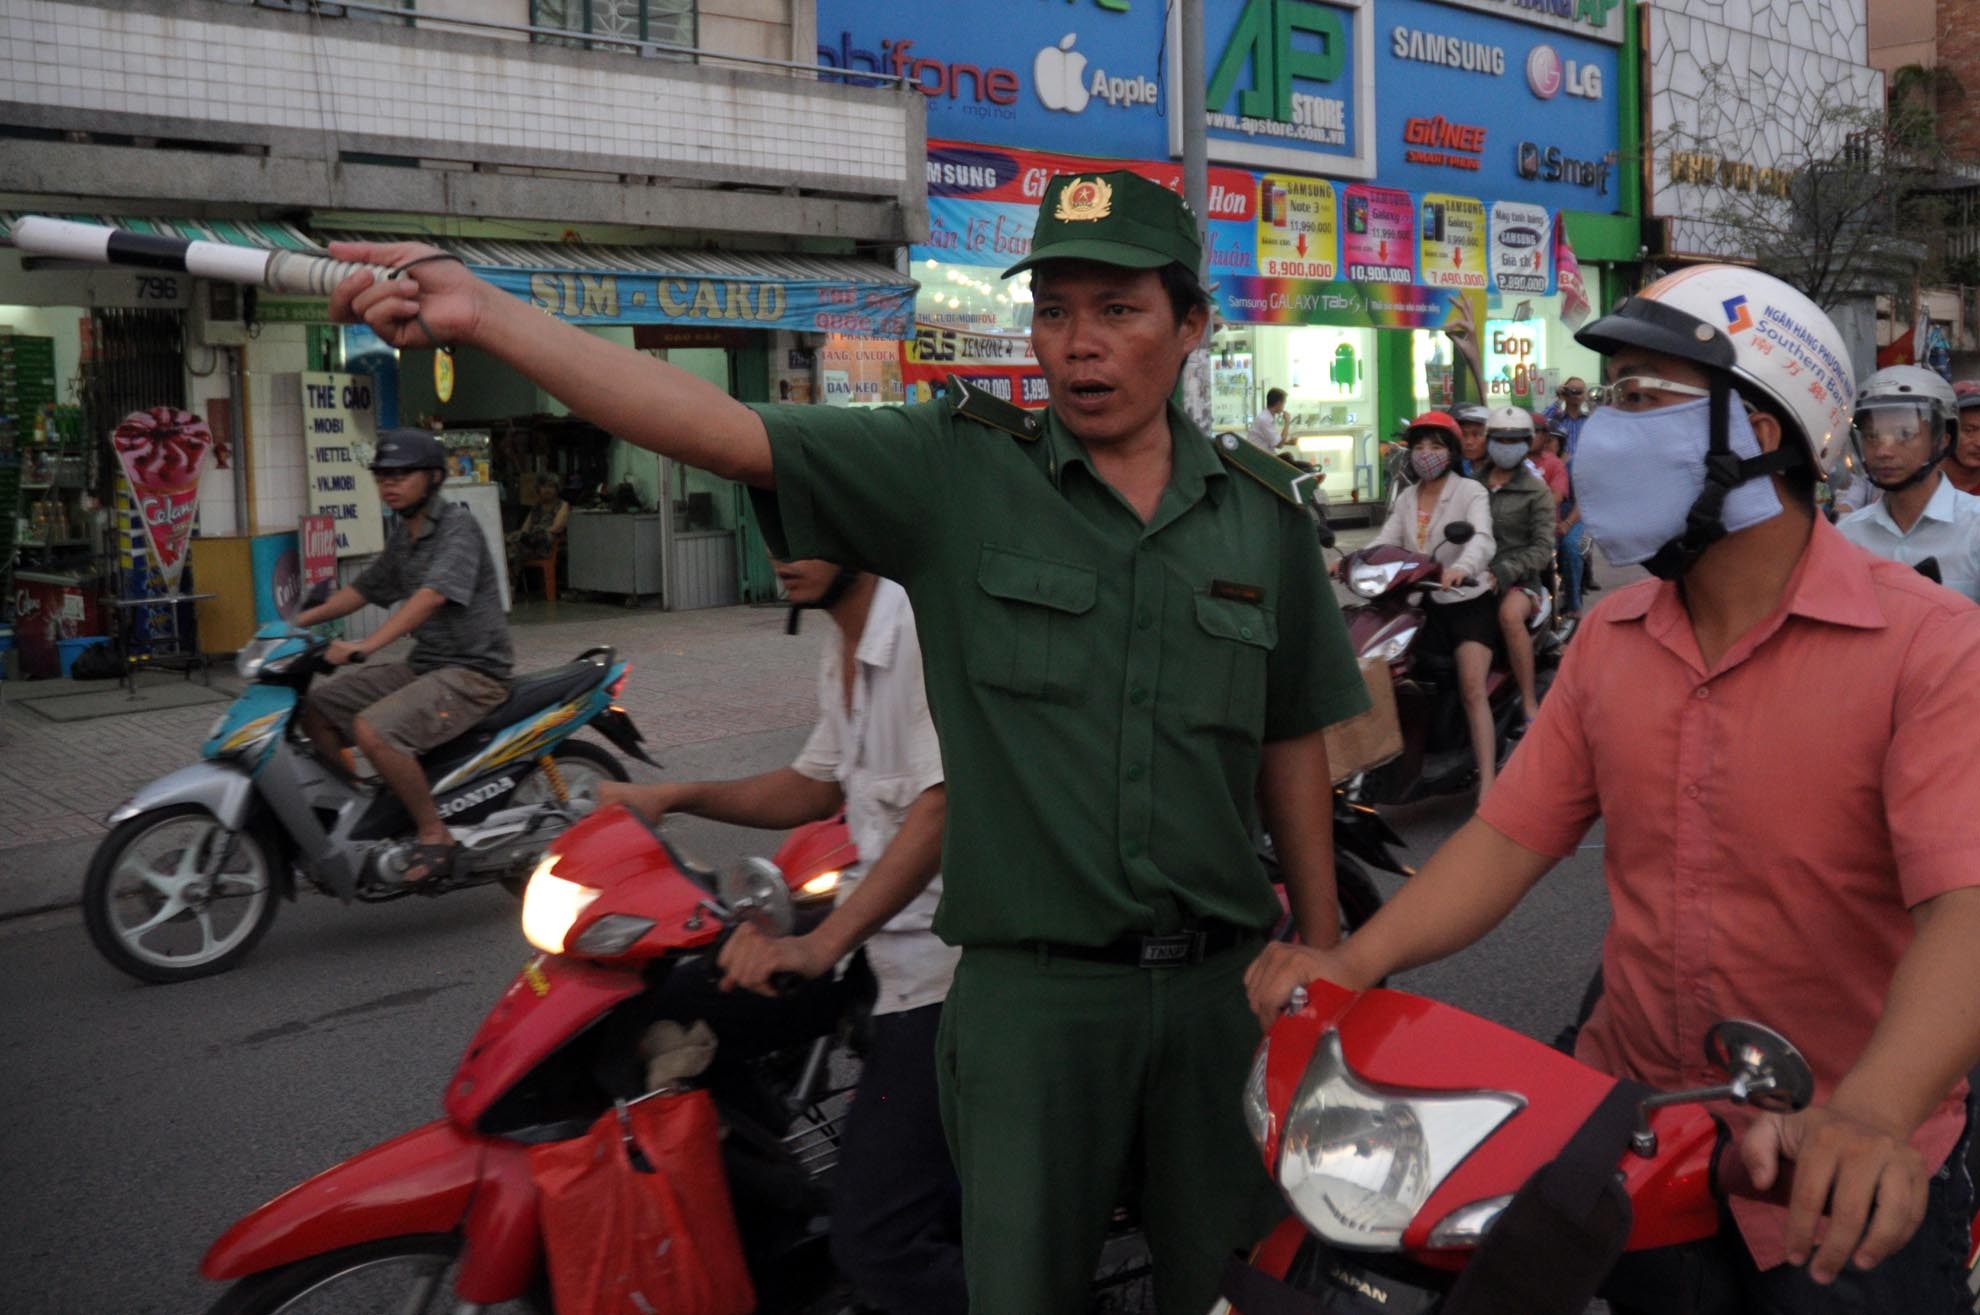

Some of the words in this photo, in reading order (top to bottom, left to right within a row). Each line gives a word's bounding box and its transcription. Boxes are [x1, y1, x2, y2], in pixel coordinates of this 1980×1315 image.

[1393, 26, 1505, 75] SAMSUNG
[817, 32, 1020, 106] bifone
[1565, 60, 1603, 98] LG
[1091, 68, 1157, 107] Apple
[1292, 92, 1346, 131] STORE
[1208, 184, 1247, 214] Hơn
[1287, 182, 1332, 198] SAMSUNG
[1290, 201, 1312, 213] Note
[1314, 204, 1320, 212] 3
[1268, 260, 1332, 278] 8,900,000
[1350, 264, 1411, 283] 10,900,000
[136, 276, 178, 299] 796
[530, 272, 620, 317] SIM
[656, 277, 788, 322] CARD
[1228, 295, 1268, 309] Samsung
[1270, 293, 1319, 310] GALAXY
[1755, 319, 1826, 381] Southern
[1021, 378, 1049, 402] 3,890
[313, 417, 345, 434] MOBI
[315, 446, 352, 464] VIETTEL
